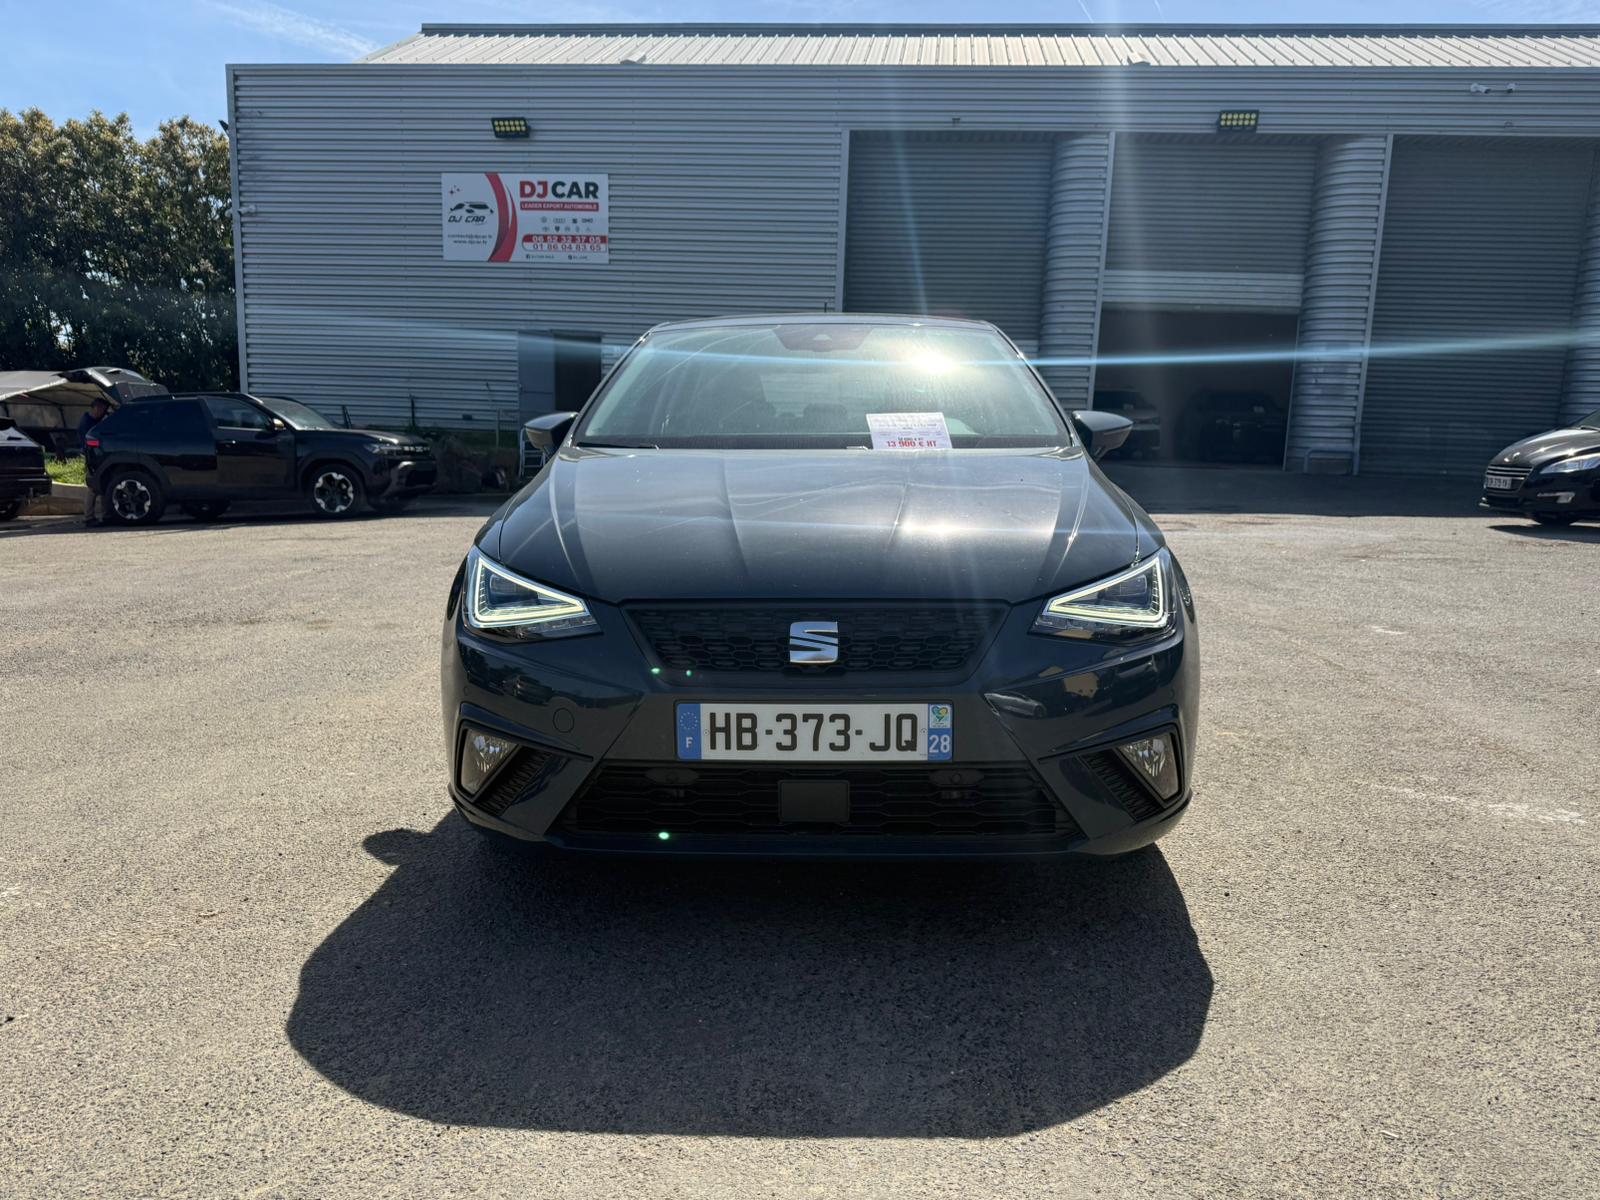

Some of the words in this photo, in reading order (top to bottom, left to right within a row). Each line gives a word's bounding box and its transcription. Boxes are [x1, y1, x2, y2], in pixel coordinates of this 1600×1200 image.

[519, 180, 548, 199] DJ
[551, 180, 599, 199] CAR
[448, 215, 463, 223] DJ
[464, 215, 486, 223] CAR
[589, 236, 601, 244] 05
[709, 712, 918, 752] HB-373-JQ
[685, 737, 693, 748] F
[929, 734, 951, 753] 28
